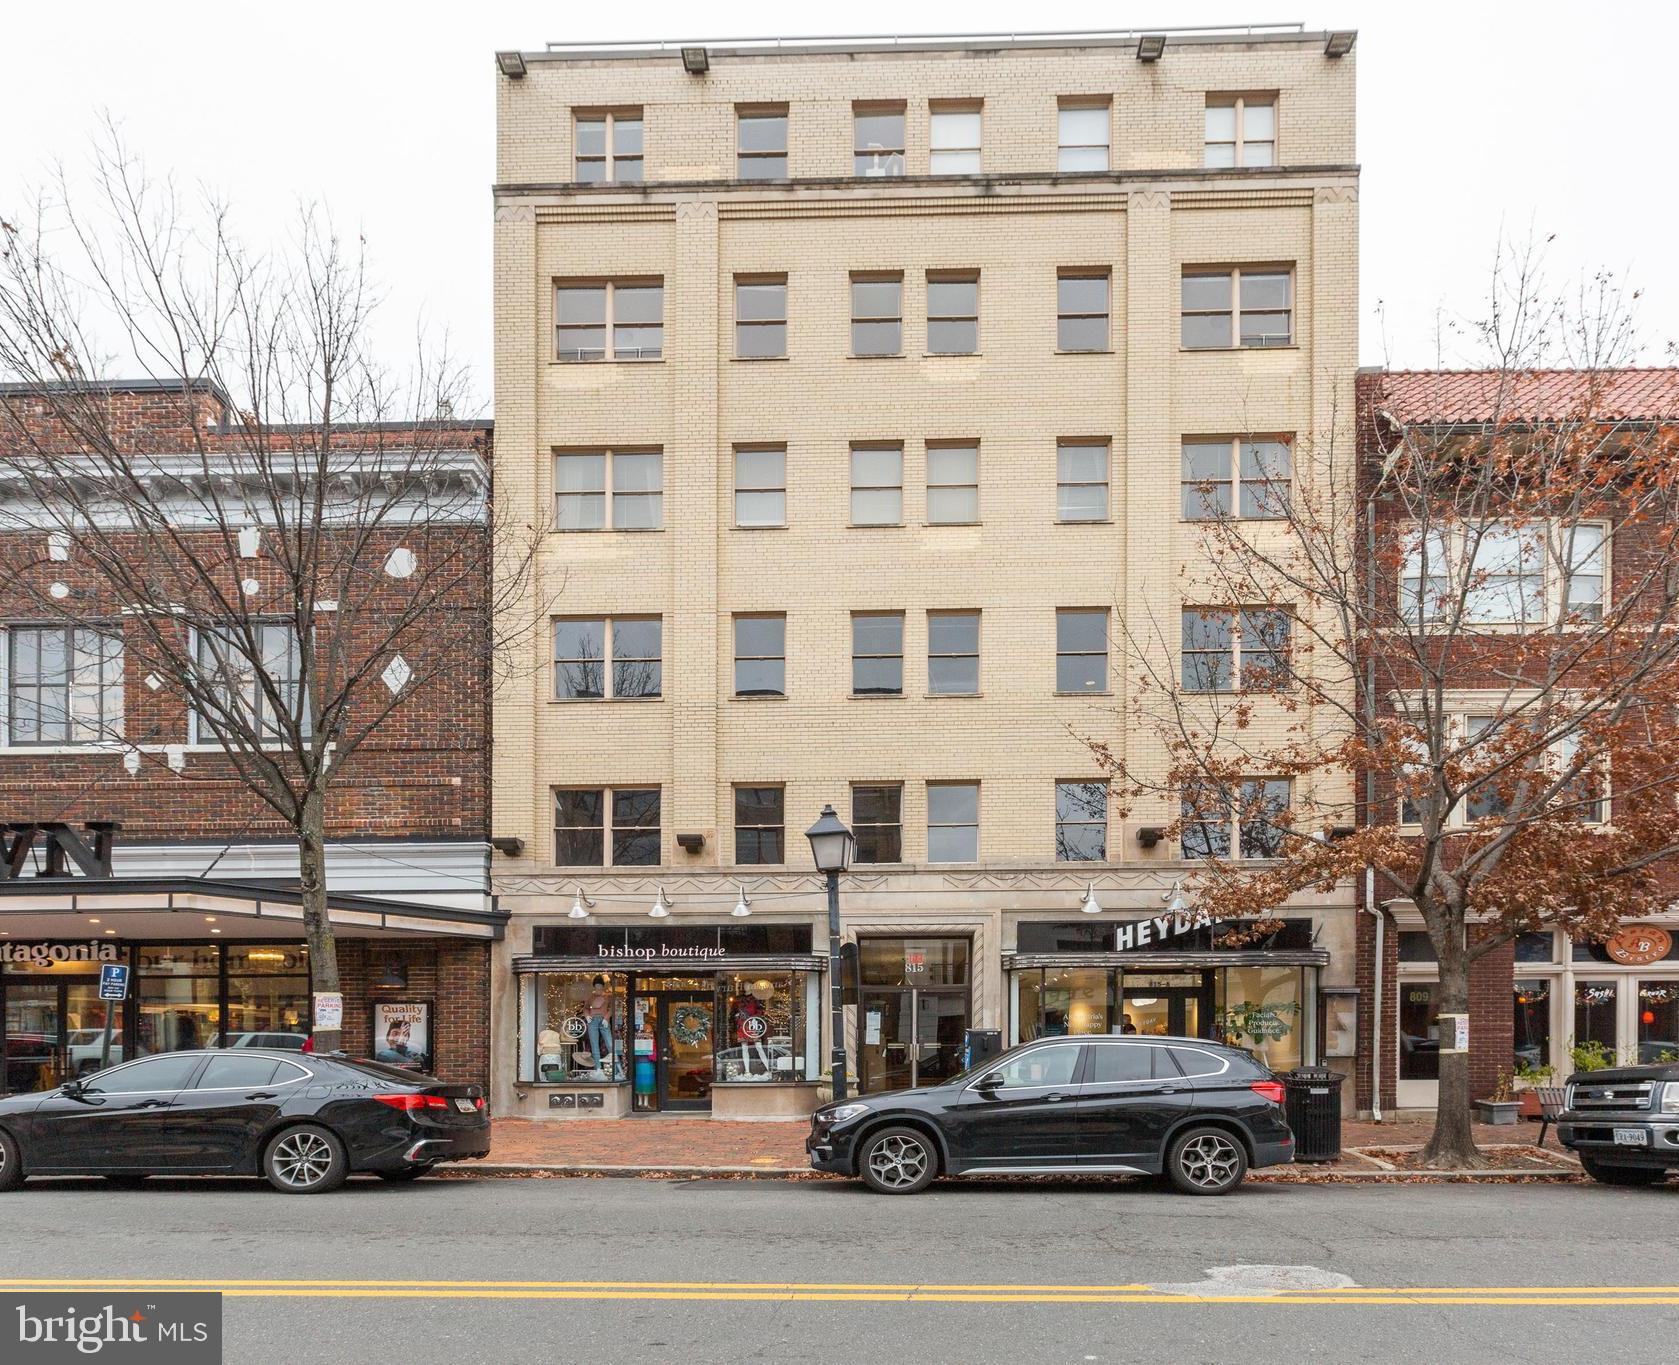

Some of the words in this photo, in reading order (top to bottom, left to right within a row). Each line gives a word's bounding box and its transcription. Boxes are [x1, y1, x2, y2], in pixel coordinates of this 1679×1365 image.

[1116, 908, 1223, 951] HEYDA
[0, 940, 117, 967] tagonia
[598, 944, 656, 960] bishop
[661, 944, 726, 960] boutique
[1615, 947, 1665, 961] Bistro
[112, 968, 120, 977] P
[905, 962, 924, 973] 815
[1410, 991, 1429, 1002] 809
[381, 1004, 423, 1015] Quality
[383, 1014, 400, 1024] for
[402, 1014, 422, 1024] Life
